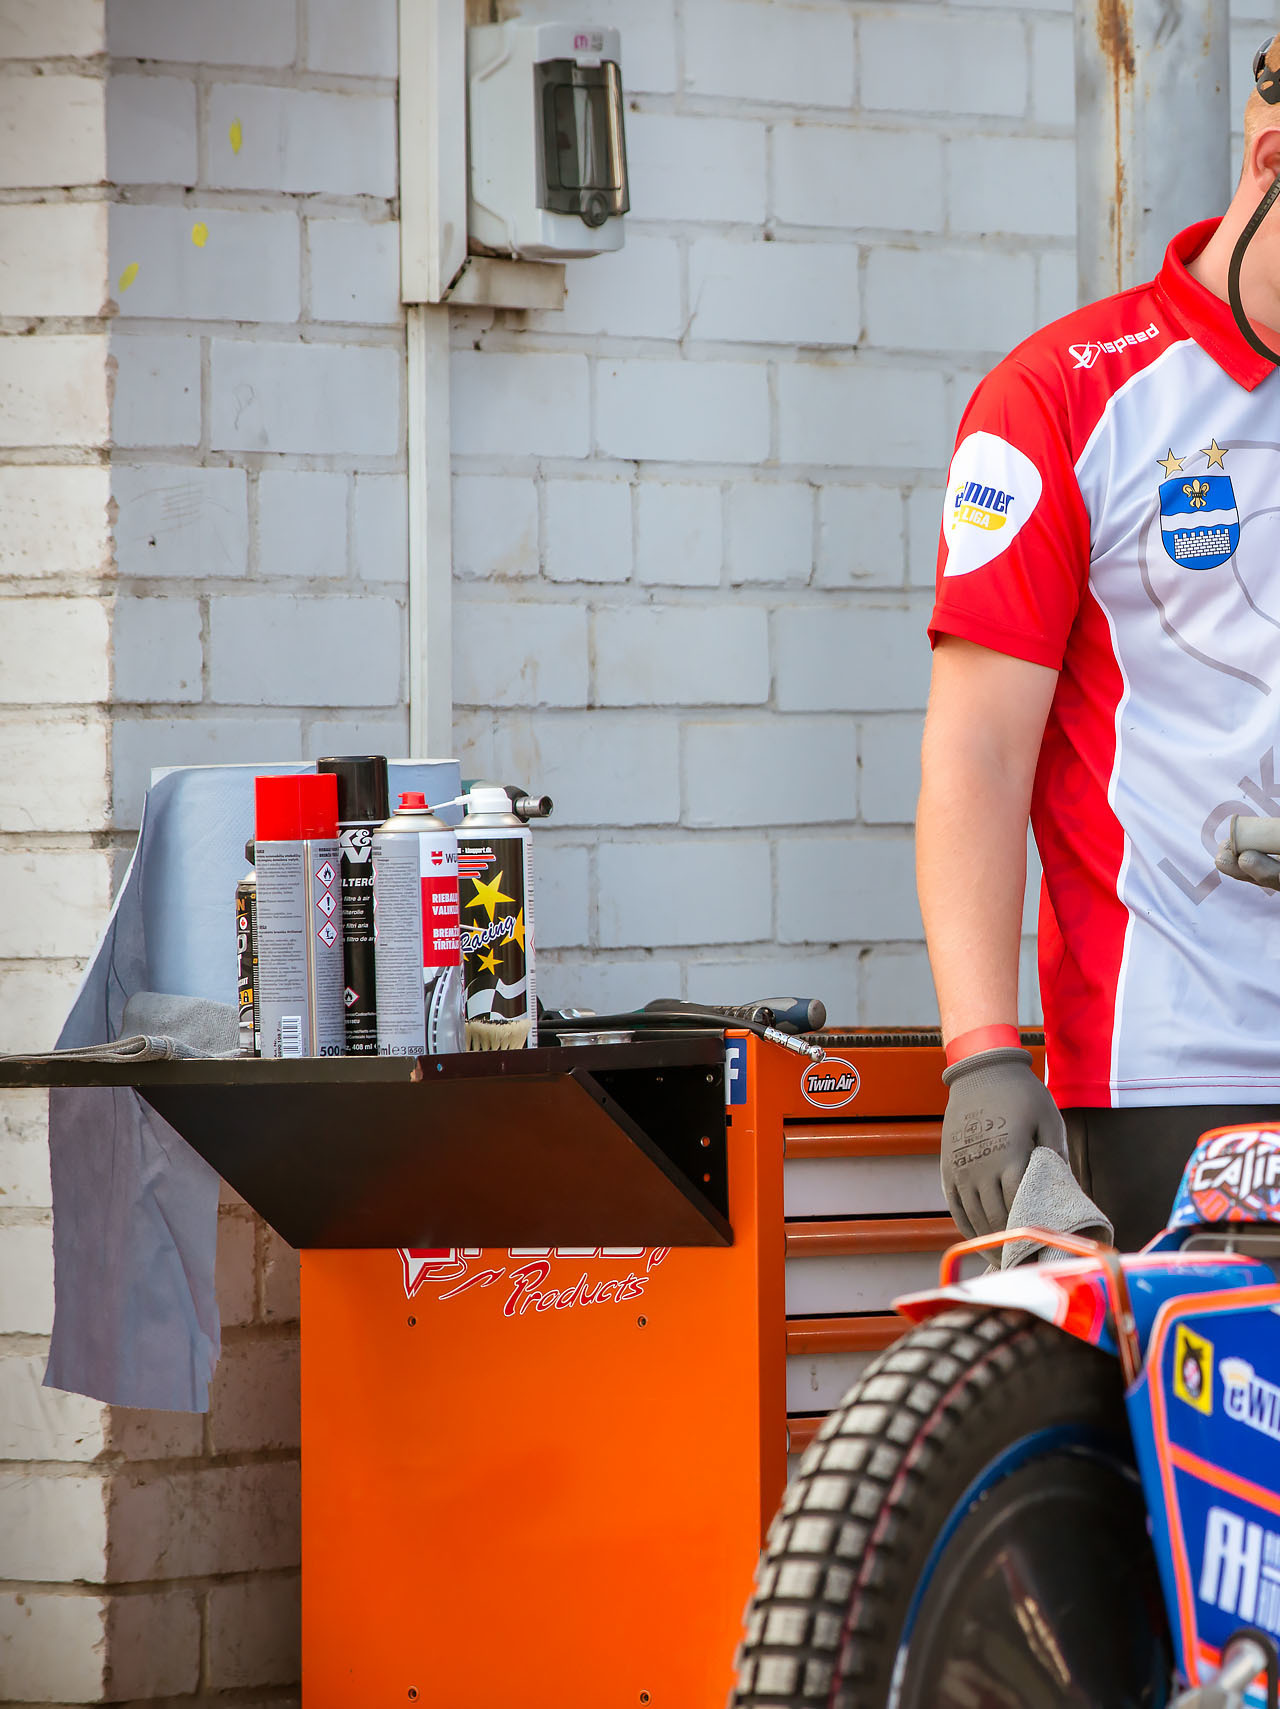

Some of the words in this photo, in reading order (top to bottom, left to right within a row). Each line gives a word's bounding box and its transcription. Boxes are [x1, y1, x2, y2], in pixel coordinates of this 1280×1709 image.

[962, 508, 991, 528] LIGA
[460, 915, 517, 953] Racing
[320, 1045, 340, 1056] 500
[808, 1074, 836, 1092] Twin
[835, 1073, 856, 1091] Air
[503, 1259, 649, 1317] Products
